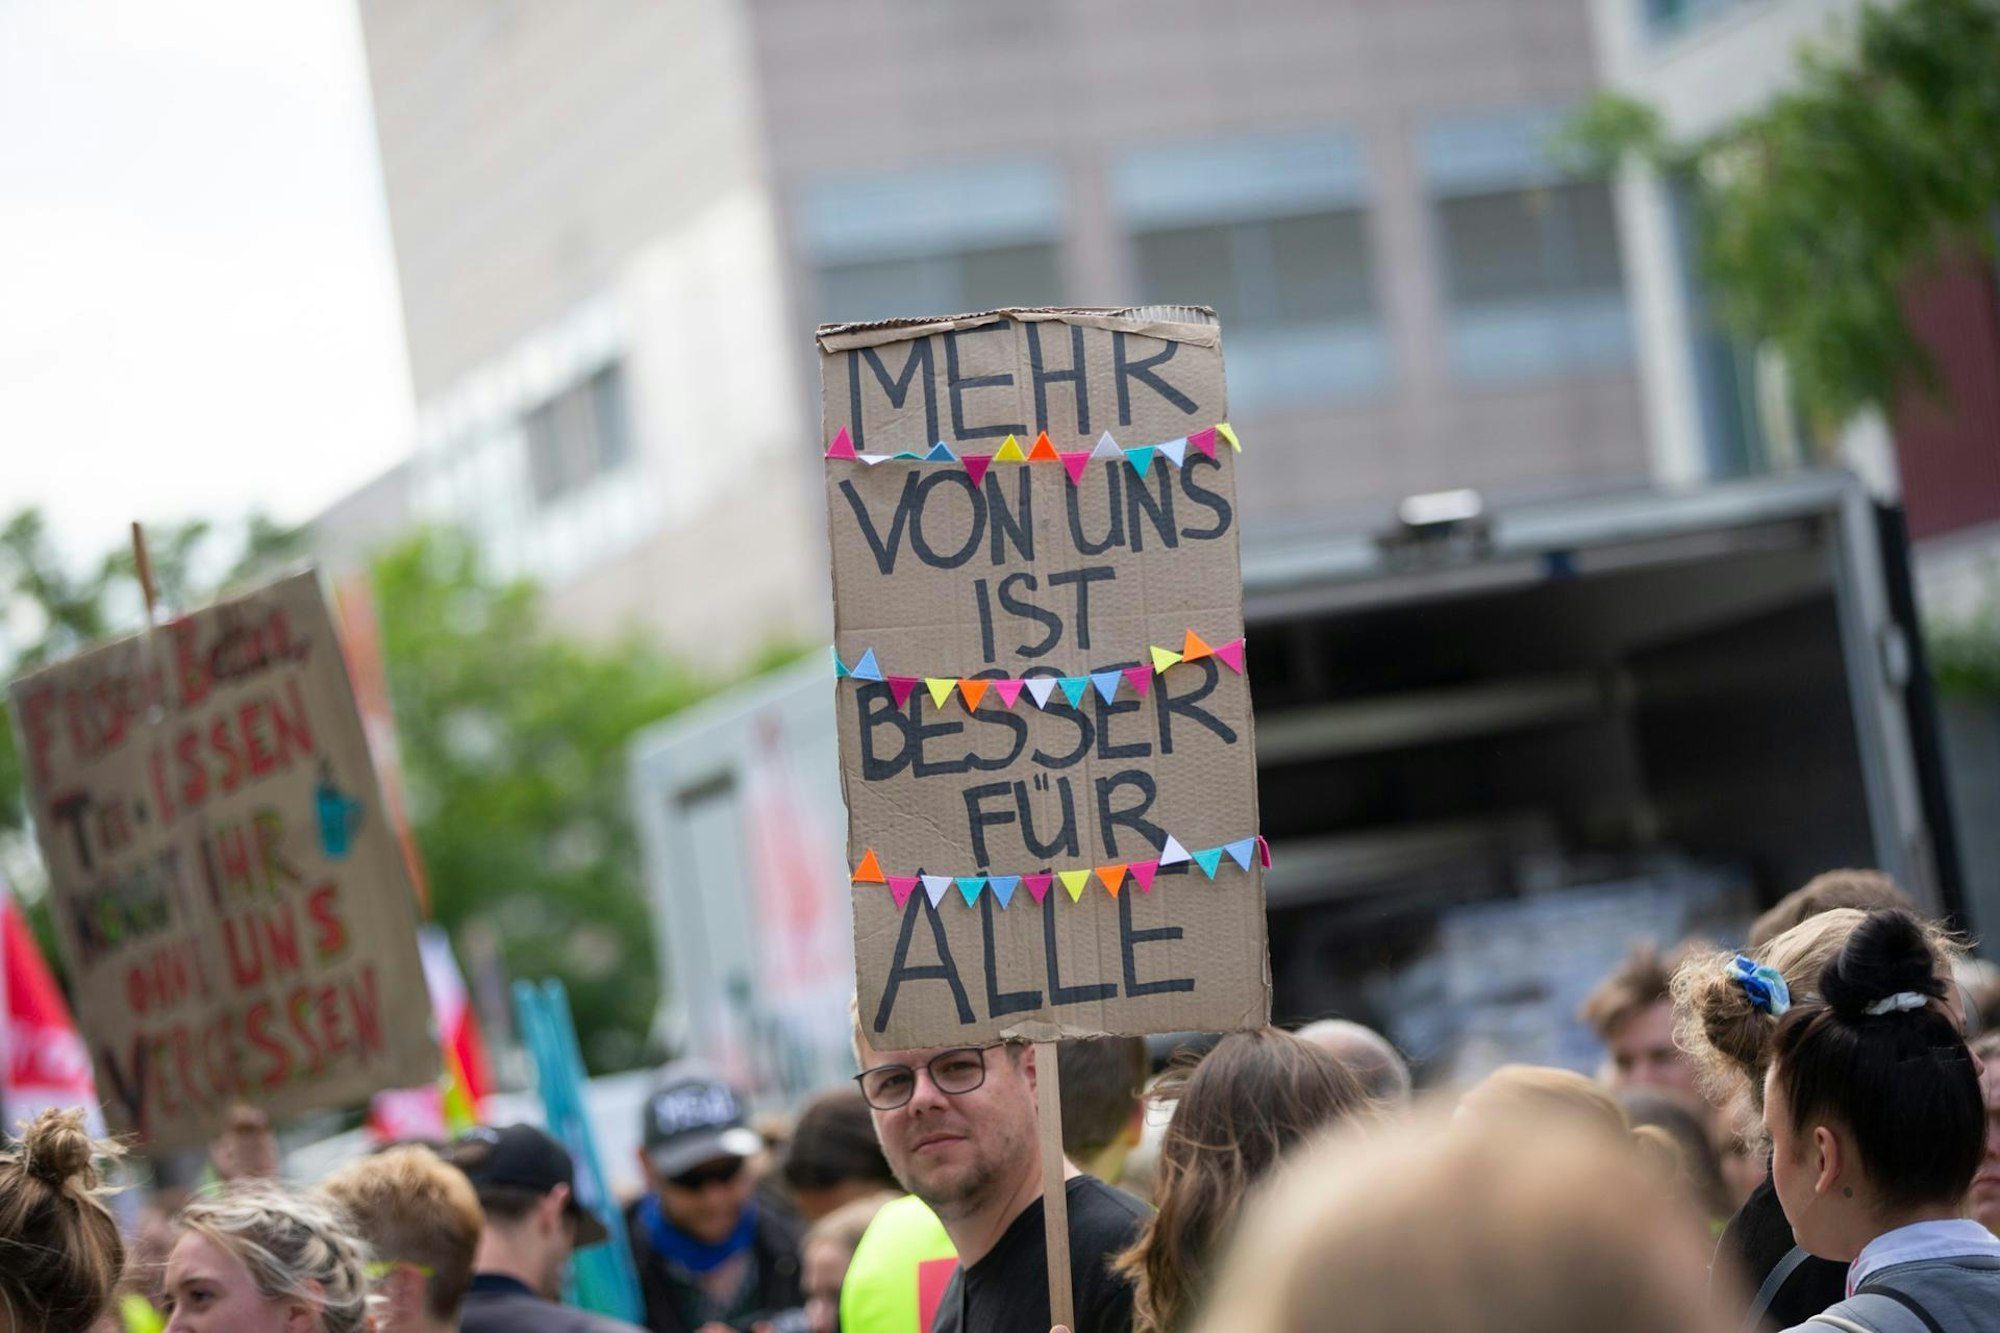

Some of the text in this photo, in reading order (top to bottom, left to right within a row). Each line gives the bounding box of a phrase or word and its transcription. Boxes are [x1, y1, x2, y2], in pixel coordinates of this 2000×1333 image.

[848, 320, 1199, 450] MEHR
[838, 452, 1233, 576] VON UNS
[974, 566, 1116, 663] IST
[856, 653, 1238, 782] BESSER
[962, 769, 1168, 869] FÜR
[223, 884, 349, 989] UNS
[873, 866, 1196, 1033] ALLE
